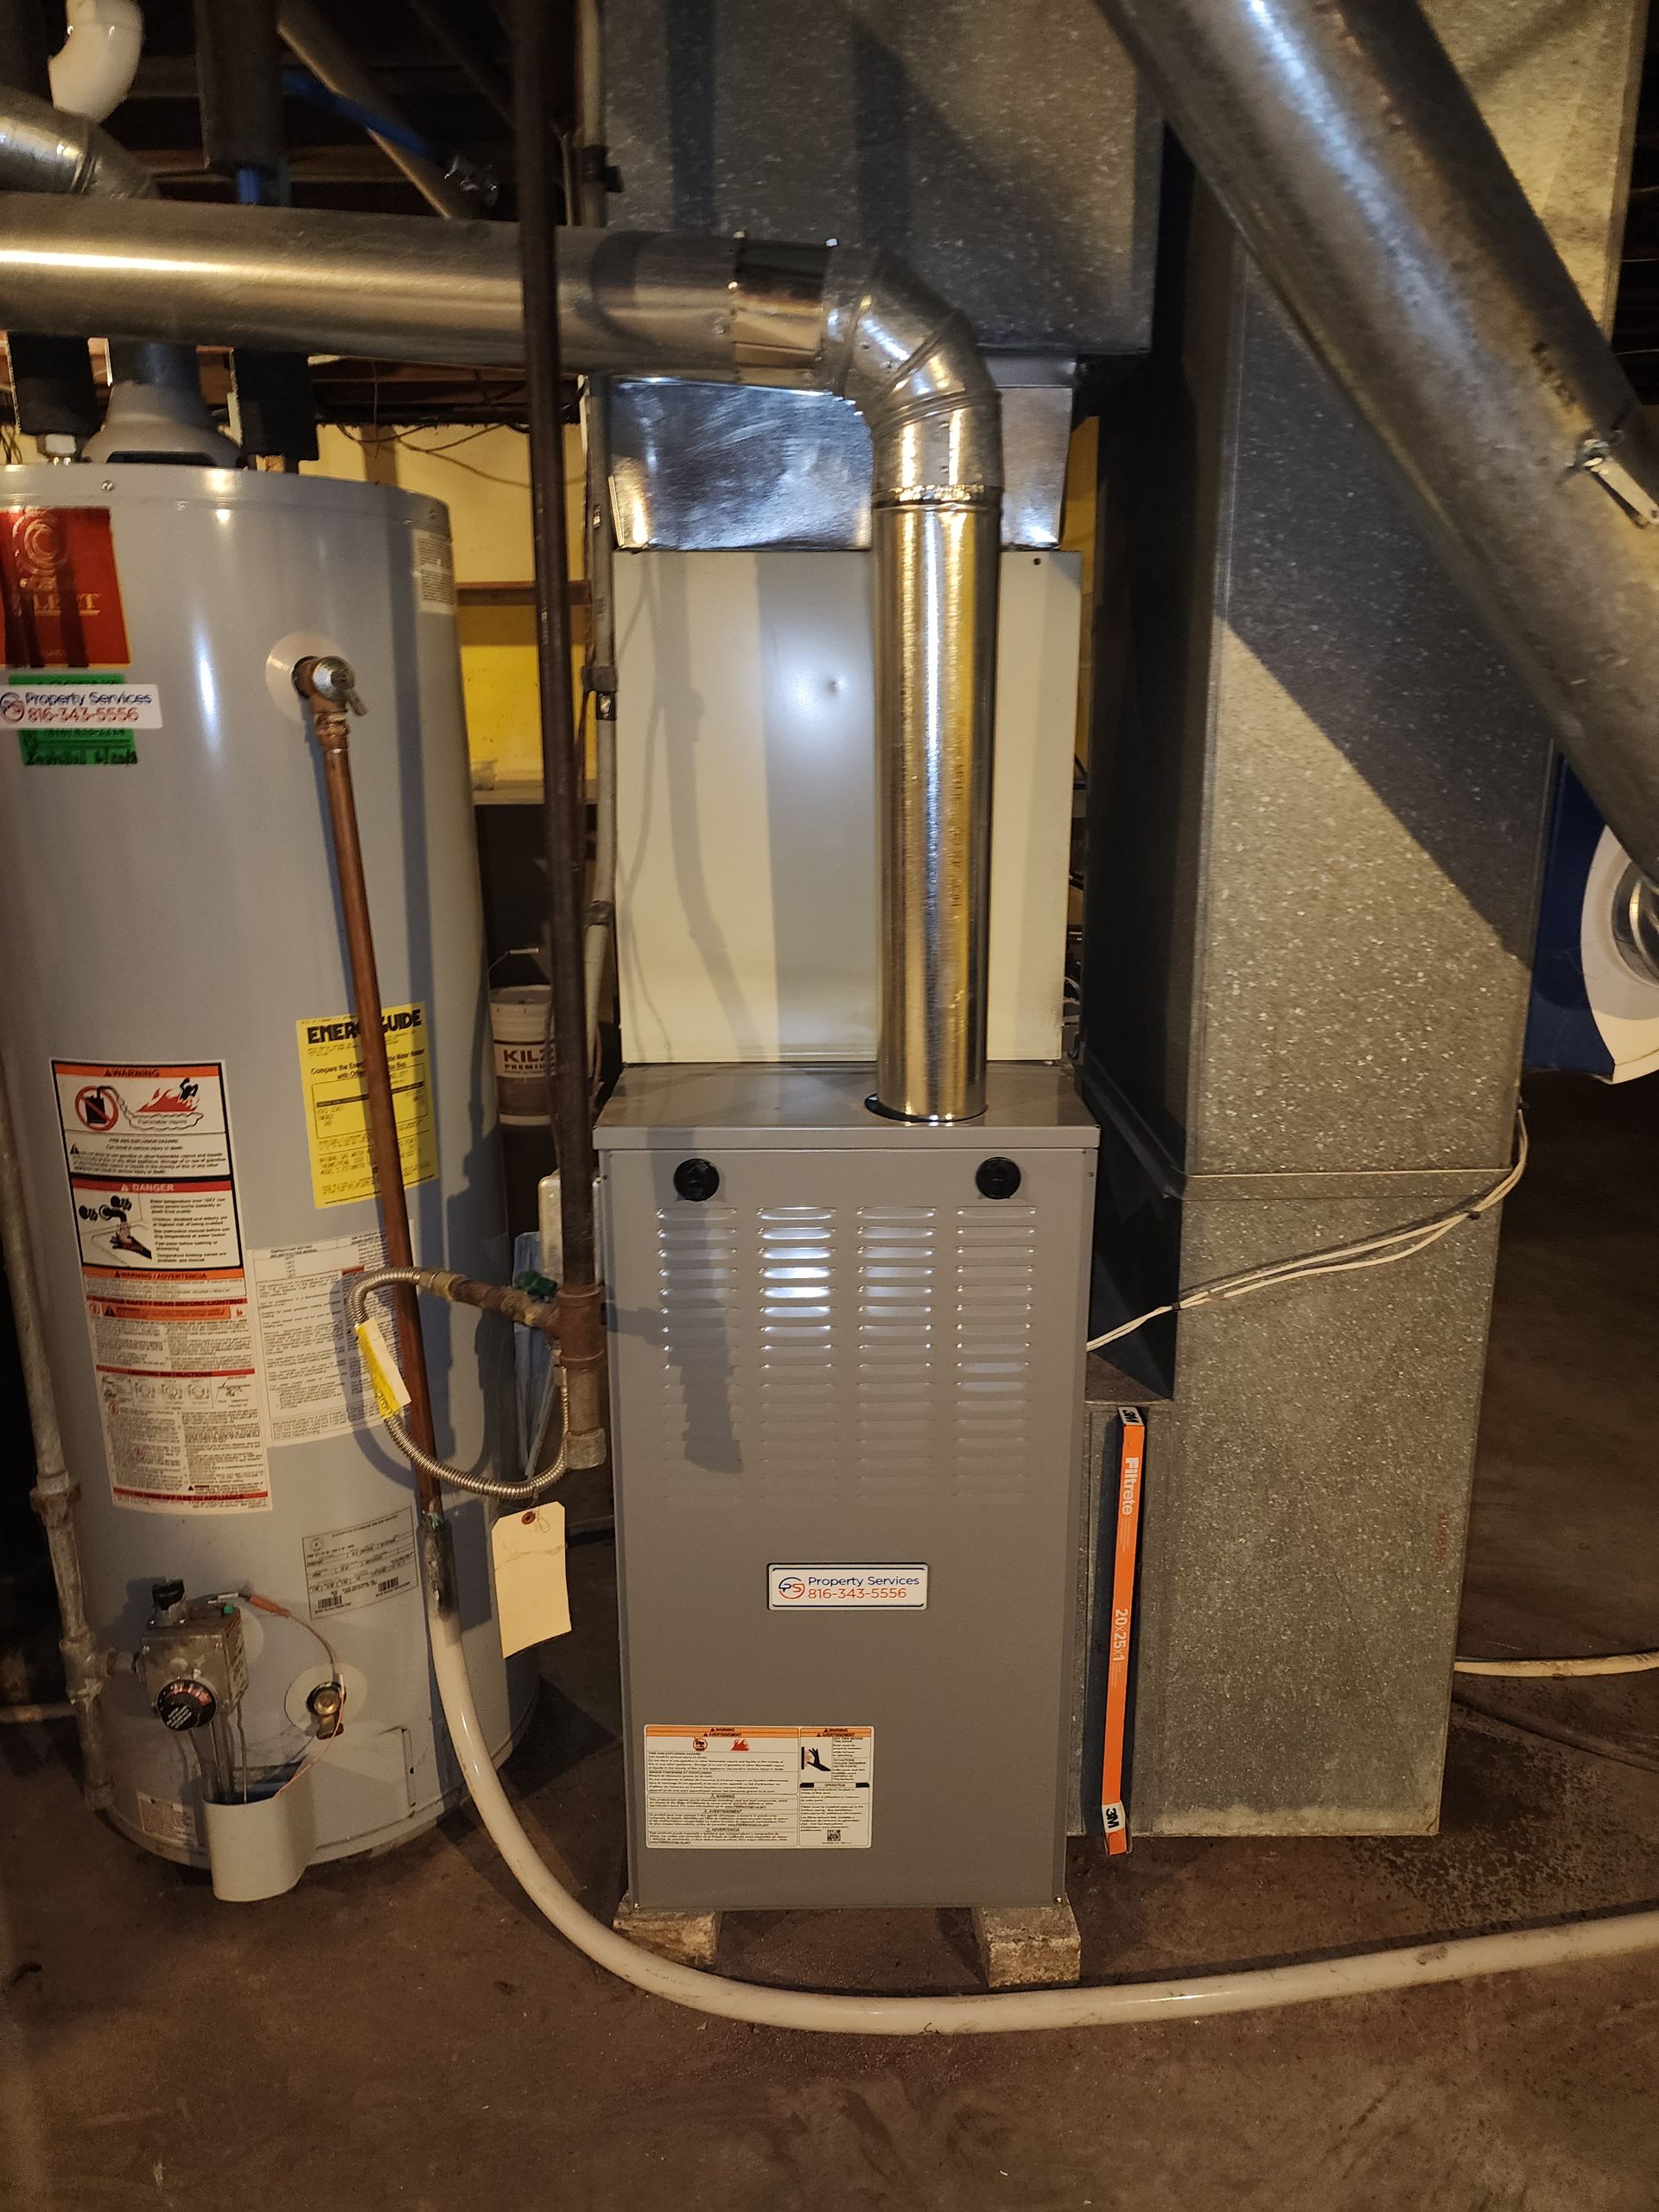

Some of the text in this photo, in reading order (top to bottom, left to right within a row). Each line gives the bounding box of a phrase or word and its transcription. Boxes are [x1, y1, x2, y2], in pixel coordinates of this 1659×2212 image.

[25, 691, 152, 706] Property Services
[28, 707, 139, 723] 816-343-5556
[111, 1069, 161, 1077] WARNING
[132, 1183, 175, 1192] DANGER
[1122, 1409, 1140, 1424] 3M
[1122, 1457, 1140, 1516] Filtrete
[808, 1576, 920, 1586] Property Services
[808, 1588, 906, 1599] 816-343-5556
[1113, 1608, 1128, 1662] 20x25x1
[1106, 1808, 1120, 1828] 3M
